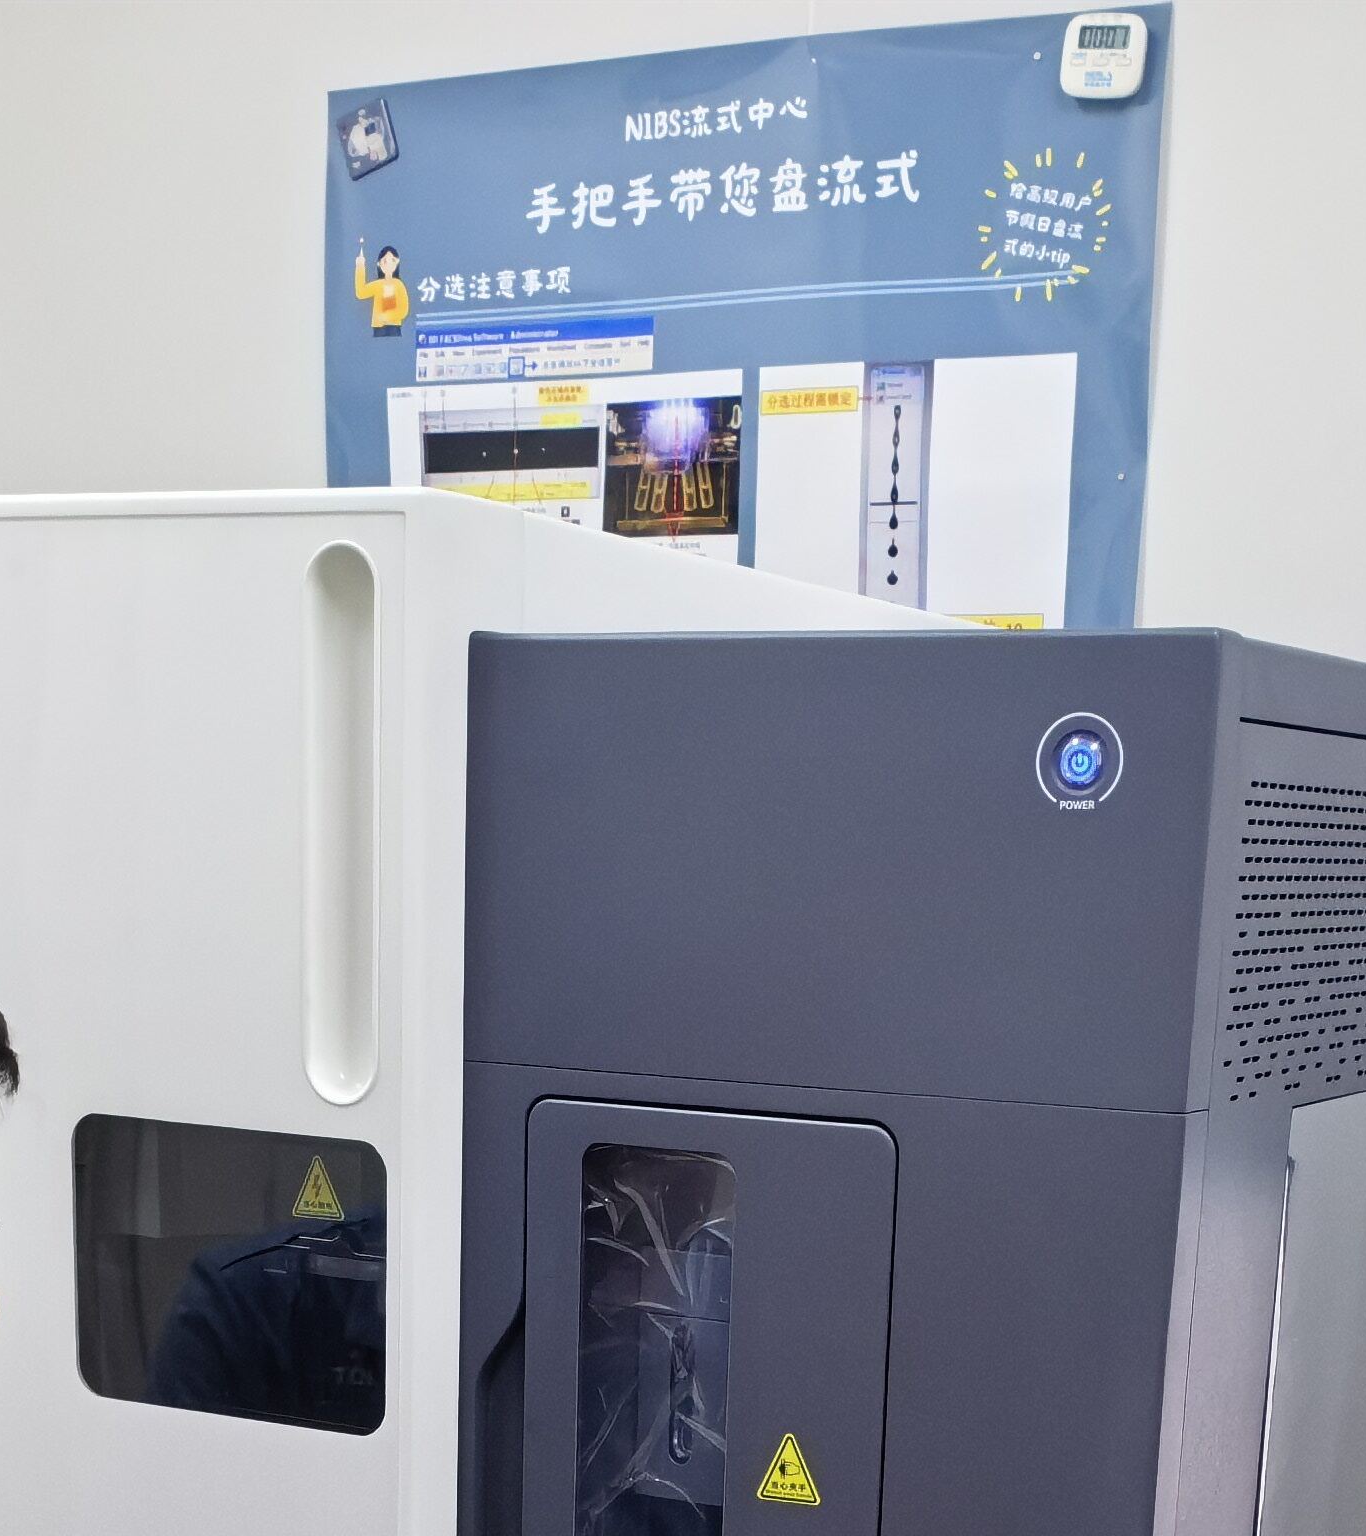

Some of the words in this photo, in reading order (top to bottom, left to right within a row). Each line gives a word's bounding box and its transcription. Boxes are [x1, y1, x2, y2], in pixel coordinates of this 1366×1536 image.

[625, 96, 808, 142] NIBS流式中心
[526, 149, 920, 234] 手把手带您盘流式
[417, 265, 572, 302] 分选注意事项
[1059, 800, 1095, 811] POWER
